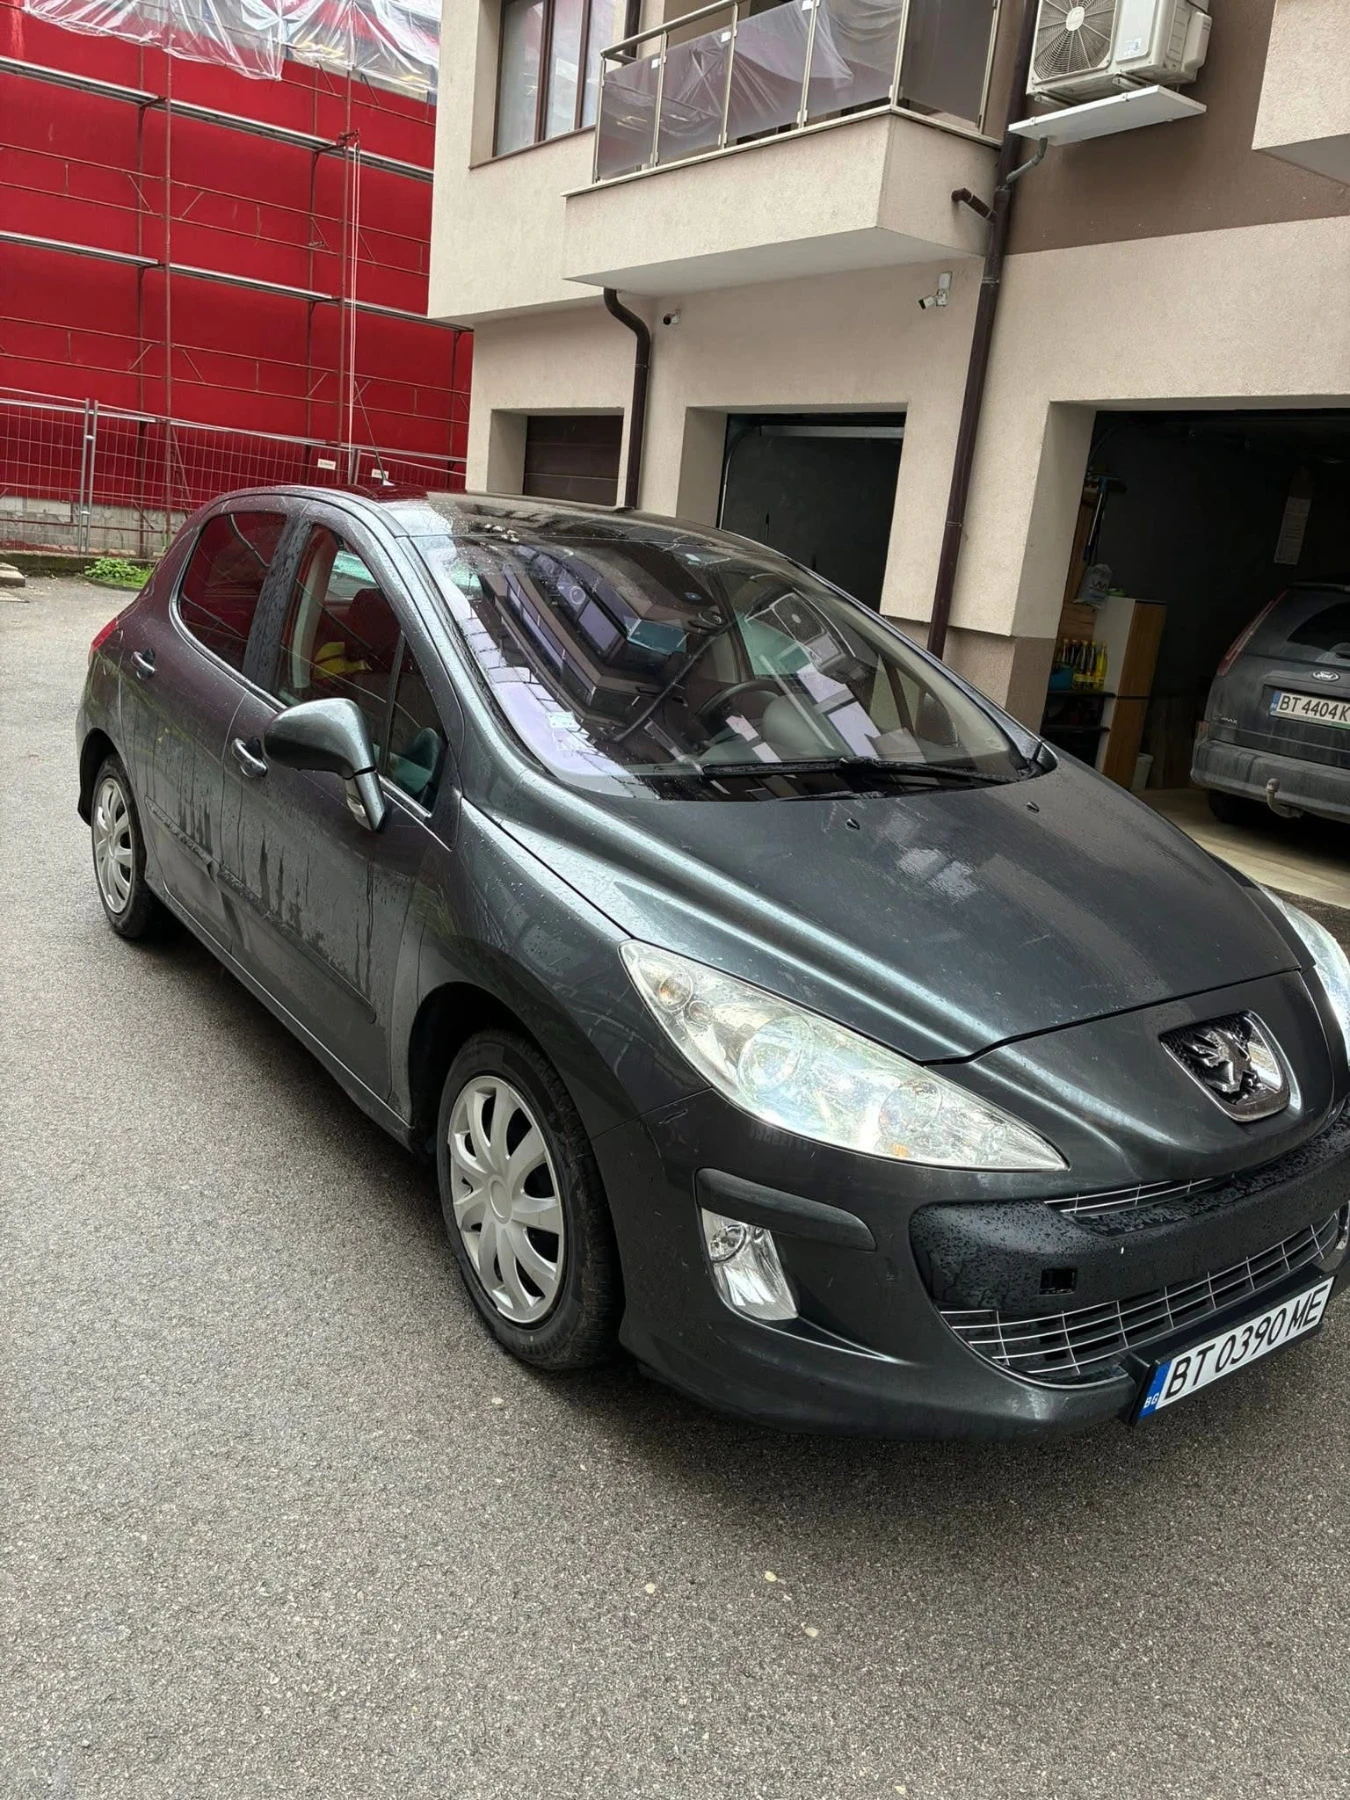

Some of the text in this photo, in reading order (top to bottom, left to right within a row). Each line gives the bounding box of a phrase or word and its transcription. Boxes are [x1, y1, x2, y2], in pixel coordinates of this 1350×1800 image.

[1280, 695, 1302, 712] BT
[1302, 700, 1339, 719] 4404
[1339, 705, 1350, 722] K
[1164, 1283, 1330, 1400] BT 0390 ME
[1143, 1392, 1160, 1409] BG
